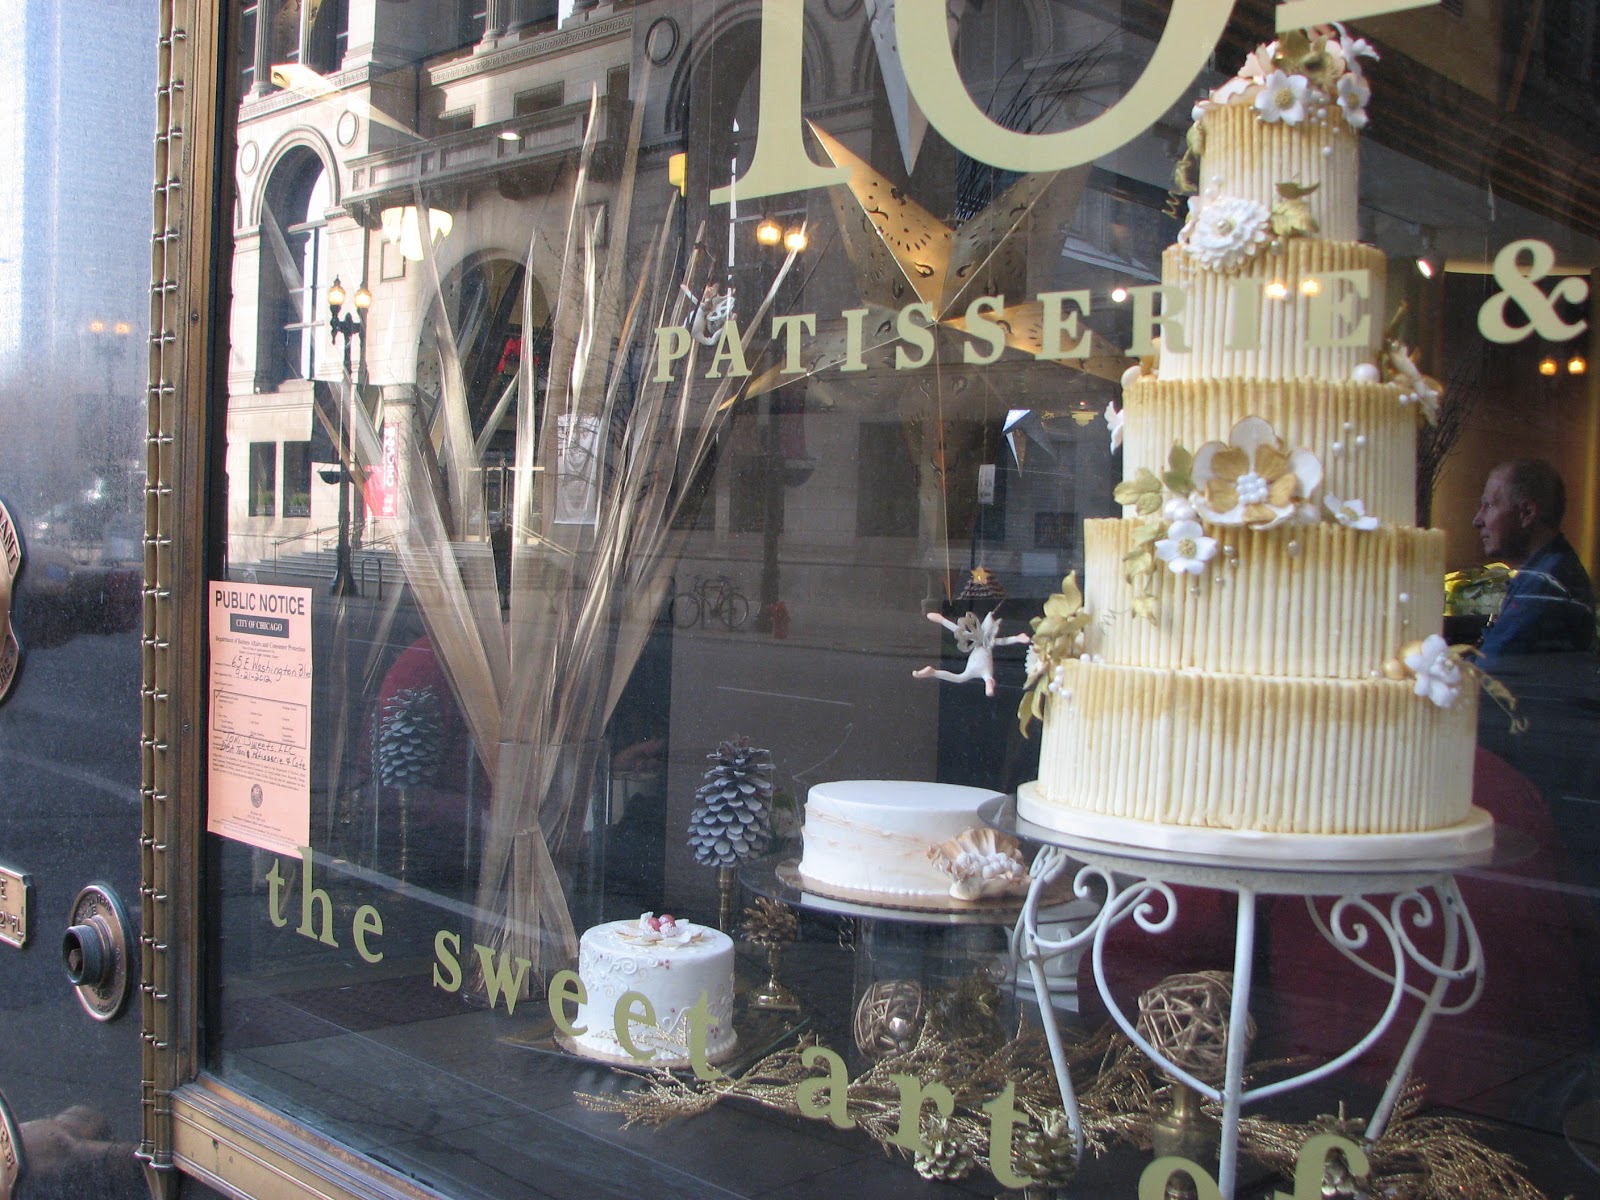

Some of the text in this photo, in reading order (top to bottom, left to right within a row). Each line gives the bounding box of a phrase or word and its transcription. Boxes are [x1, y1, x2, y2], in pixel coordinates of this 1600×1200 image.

[653, 238, 1590, 384] PATISSERIE &
[215, 590, 305, 615] PUBLIC NOTICE
[236, 619, 283, 632] CITY OF CHICAGO
[265, 846, 384, 964] the
[432, 929, 724, 1081] sweet
[799, 1045, 1032, 1190] art
